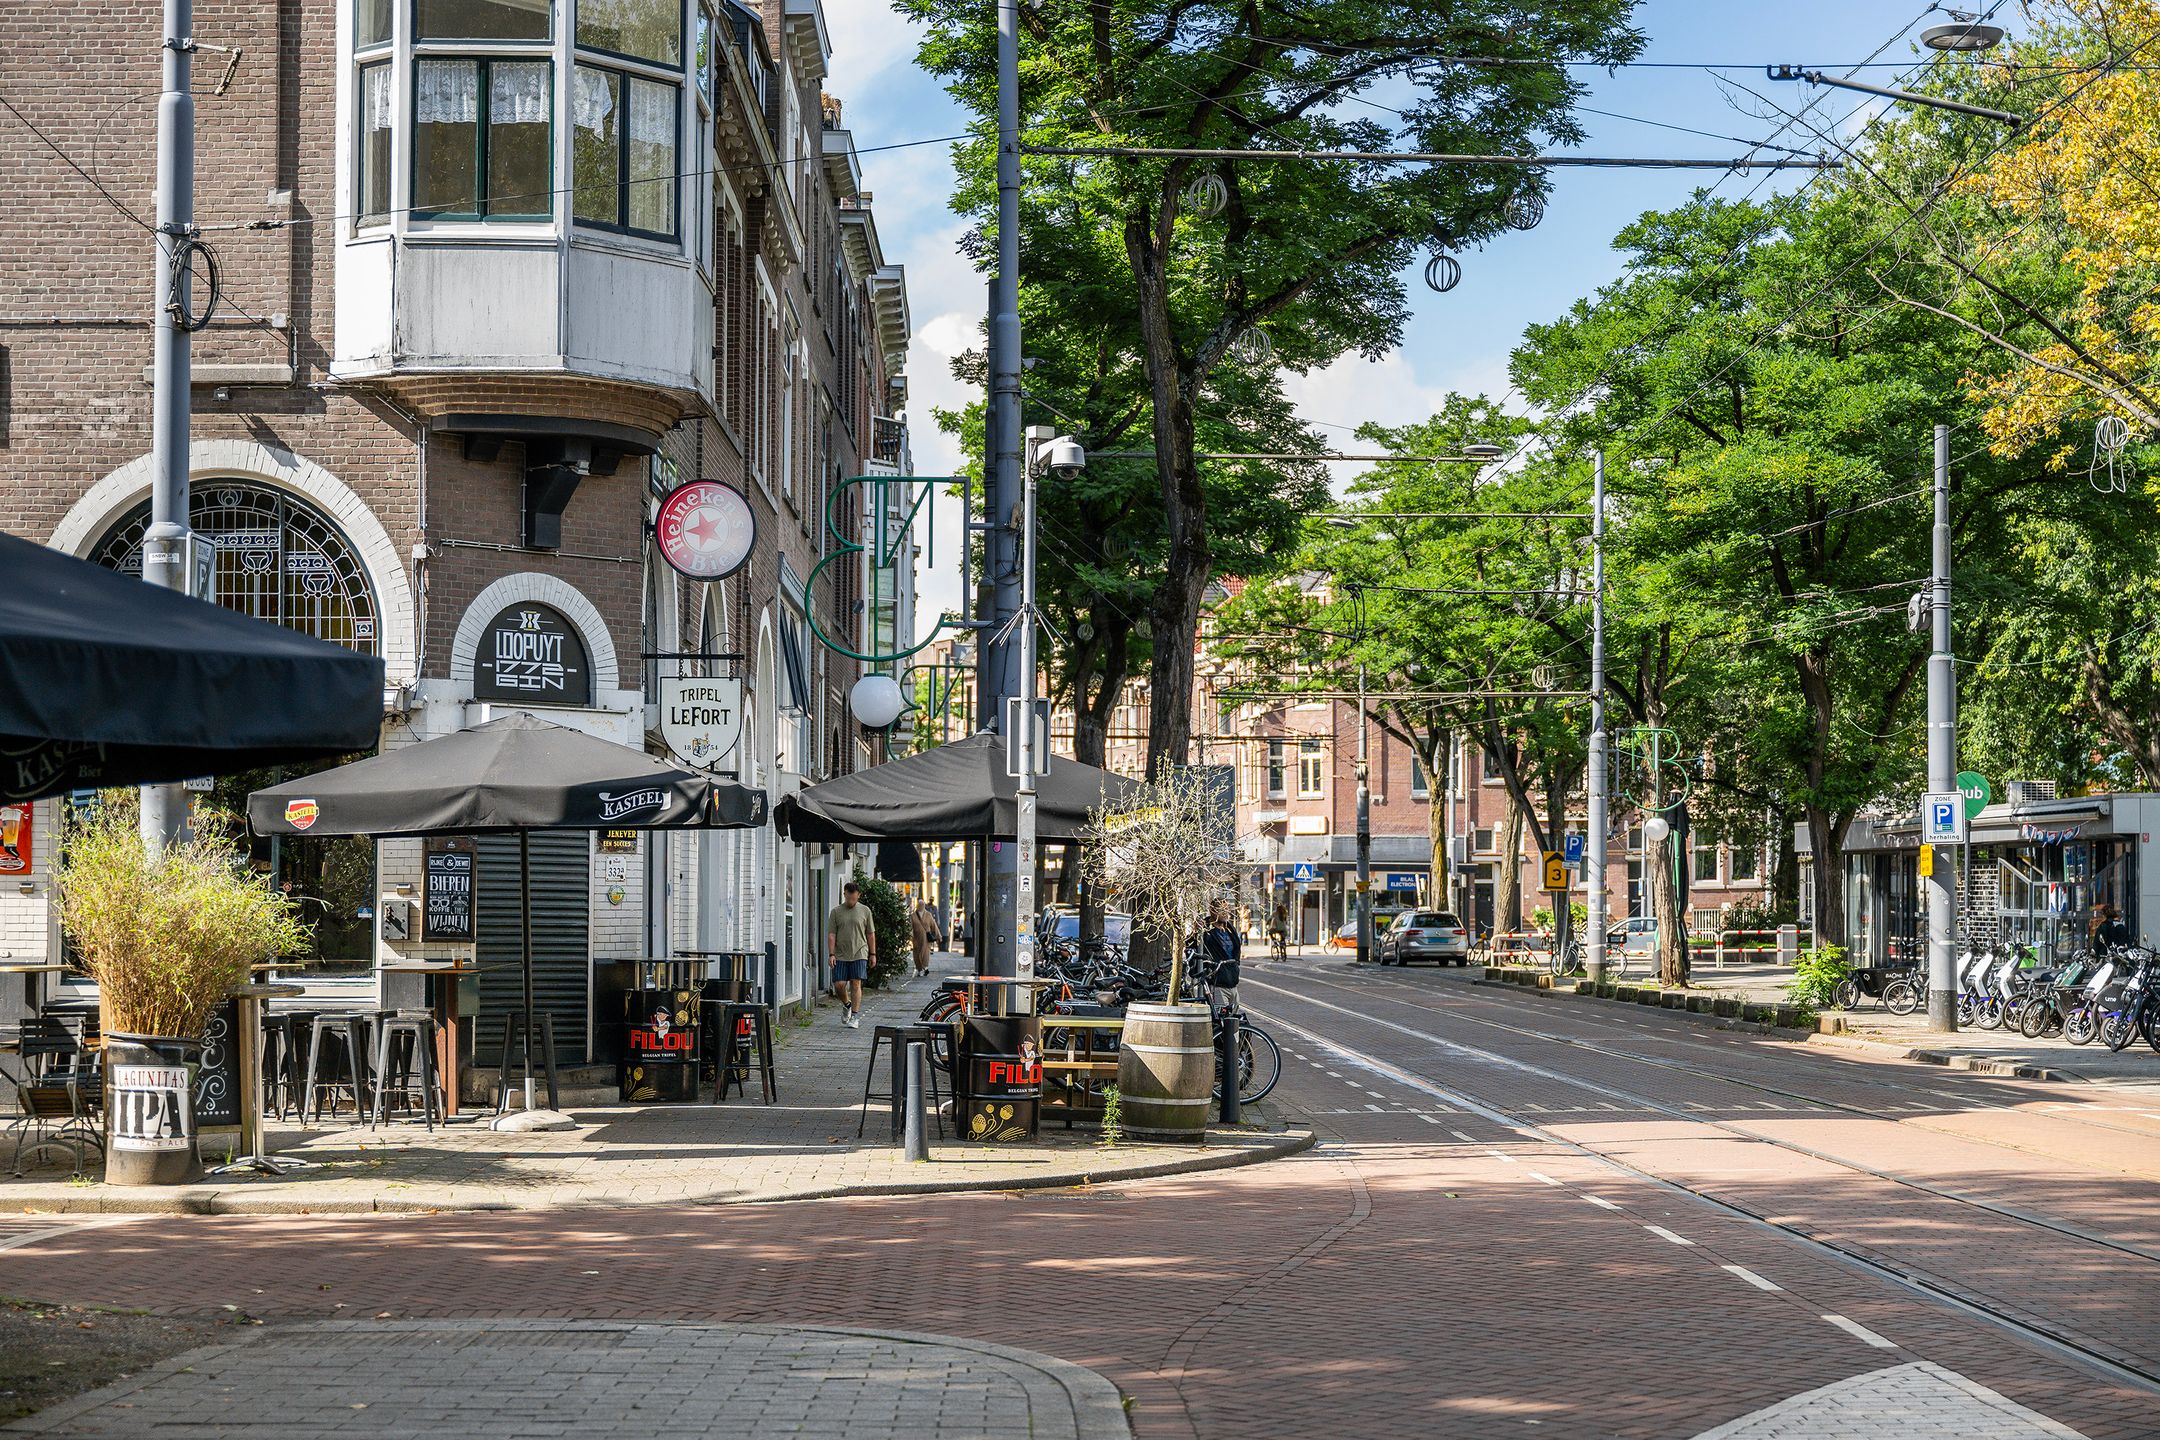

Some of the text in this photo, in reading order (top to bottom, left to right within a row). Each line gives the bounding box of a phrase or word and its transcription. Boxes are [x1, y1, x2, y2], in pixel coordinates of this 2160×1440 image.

[496, 631, 564, 662] LOOPUYT
[496, 674, 564, 690] GIN
[680, 688, 721, 703] TRIPEL
[604, 792, 662, 816] KASTEEL
[1937, 805, 1950, 823] P
[607, 829, 637, 838] JENEVER
[1569, 837, 1580, 851] P
[430, 875, 470, 892] BIEREN
[1552, 868, 1562, 881] 3
[429, 914, 469, 932] WIJNEN
[631, 1029, 694, 1051] FILOU
[118, 1070, 185, 1088] LAGUNITAS
[989, 1062, 1043, 1084] FILO
[117, 1089, 186, 1139] IPA
[167, 1139, 186, 1147] ALE
